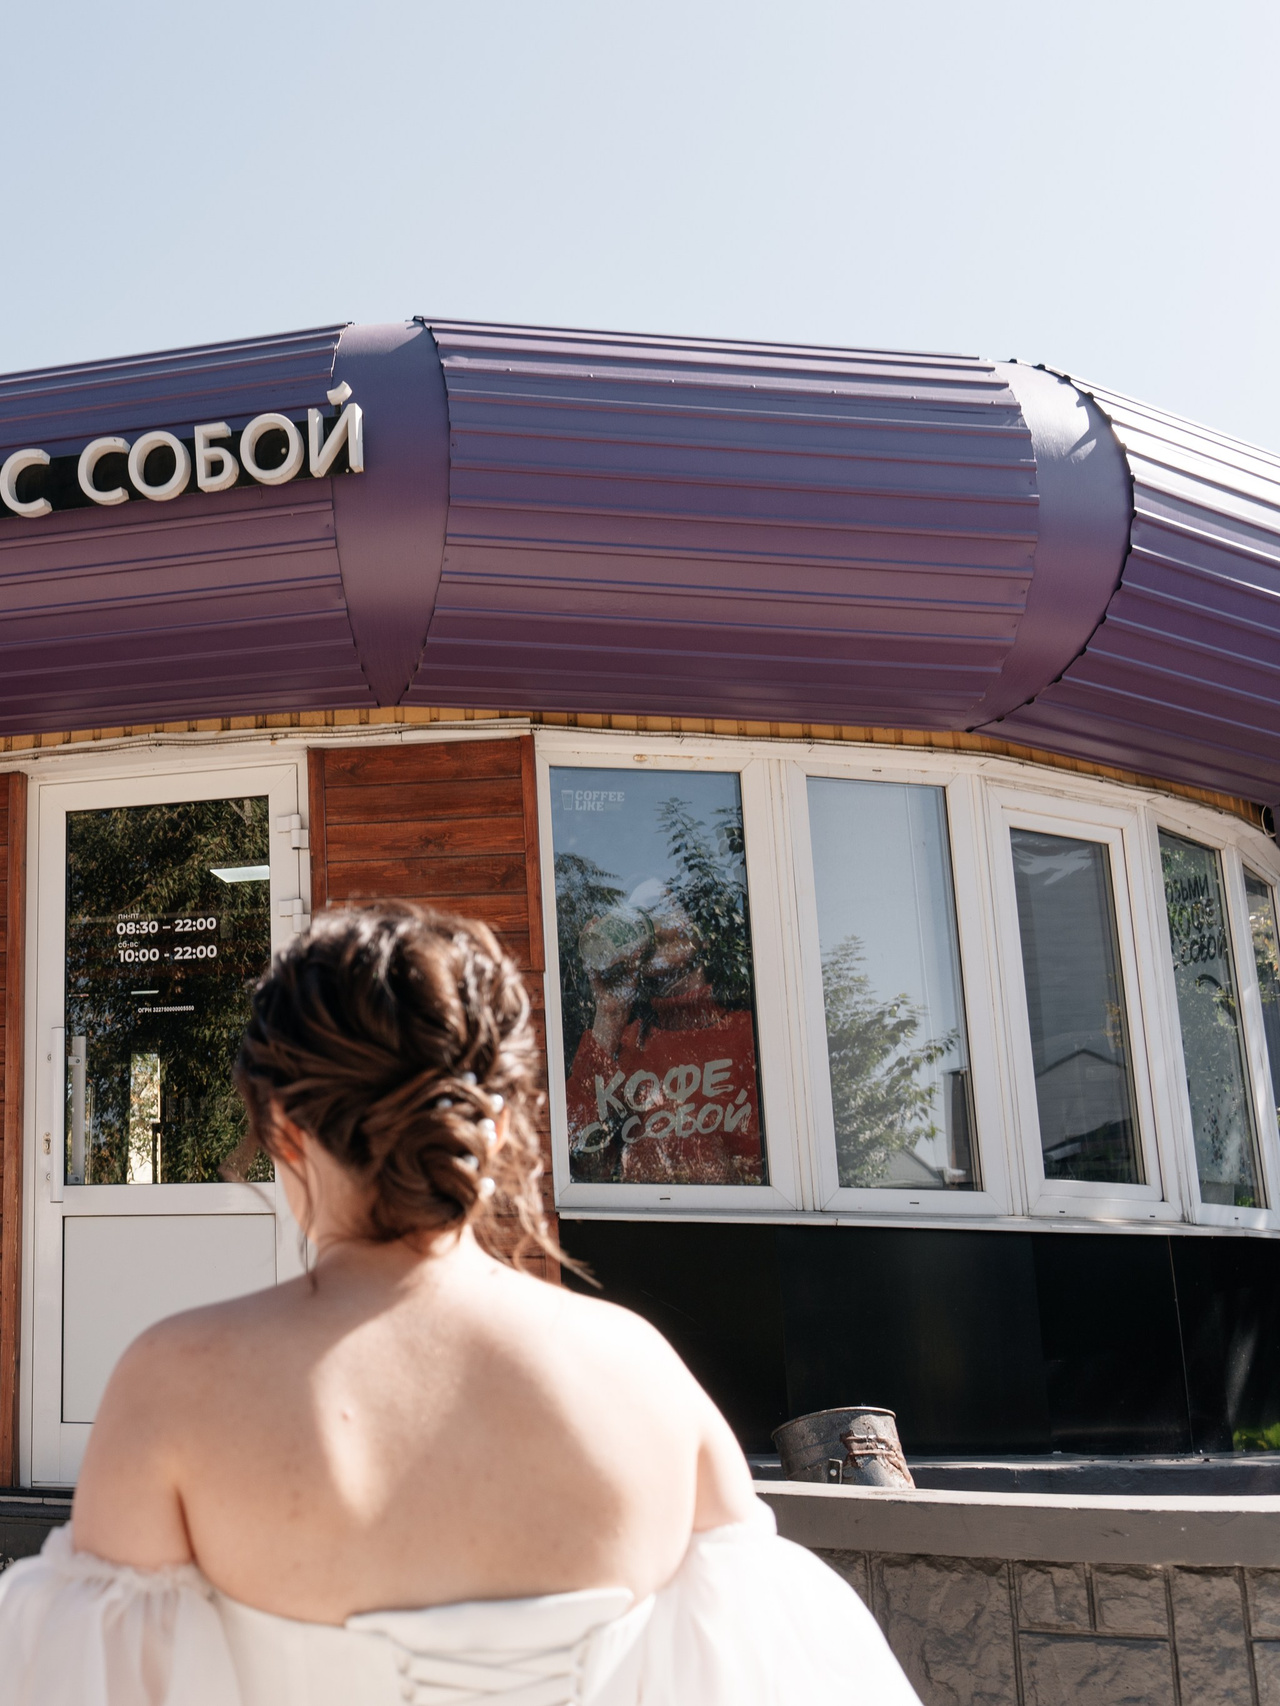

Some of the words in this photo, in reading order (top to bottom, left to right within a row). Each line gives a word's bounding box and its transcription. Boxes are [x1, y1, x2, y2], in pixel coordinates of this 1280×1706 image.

[76, 380, 365, 506] СОБОЙ
[575, 789, 625, 802] COFFEE
[574, 800, 605, 812] LIKE
[116, 921, 159, 935] 08:30
[174, 917, 217, 932] 22:00
[118, 948, 160, 963] 10:00
[173, 945, 218, 960] 22:00
[594, 1058, 734, 1121] КОФЕ
[621, 1088, 753, 1144] СОБОЙ
